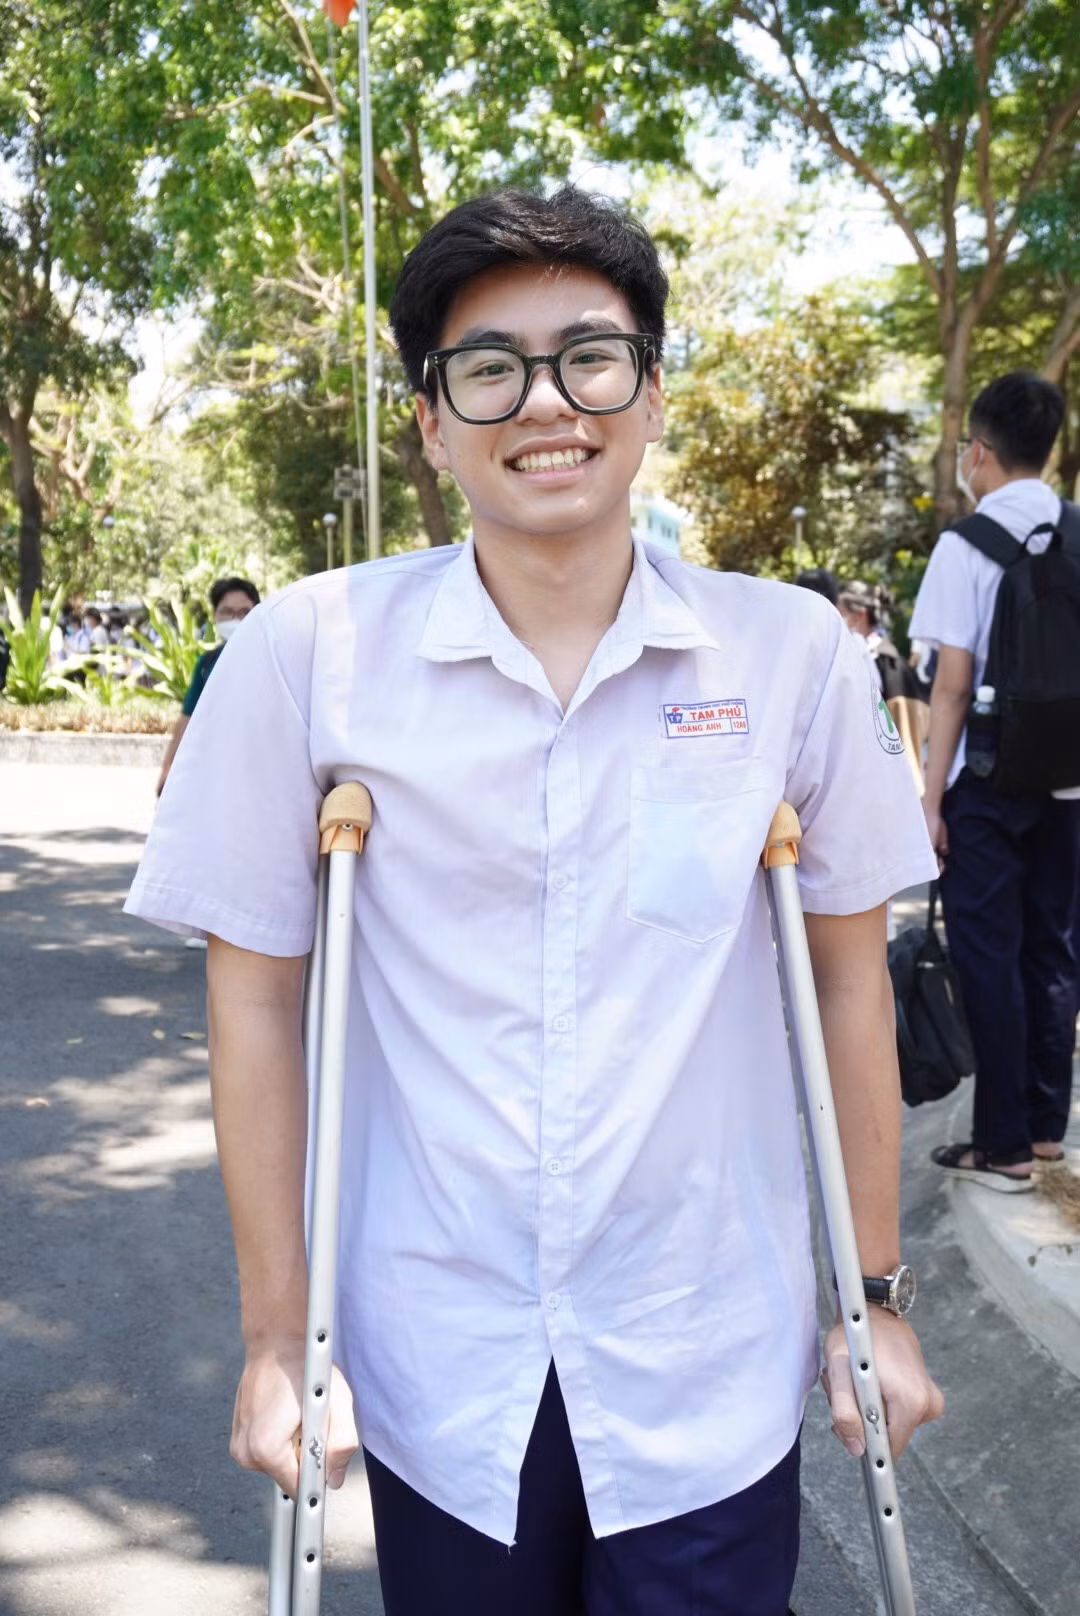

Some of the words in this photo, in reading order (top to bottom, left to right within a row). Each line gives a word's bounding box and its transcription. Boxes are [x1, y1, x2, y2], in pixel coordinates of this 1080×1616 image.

[690, 711, 714, 720] TAM
[718, 705, 741, 717] PHÚ
[677, 724, 703, 733] HOÀNG
[706, 723, 722, 731] ANH
